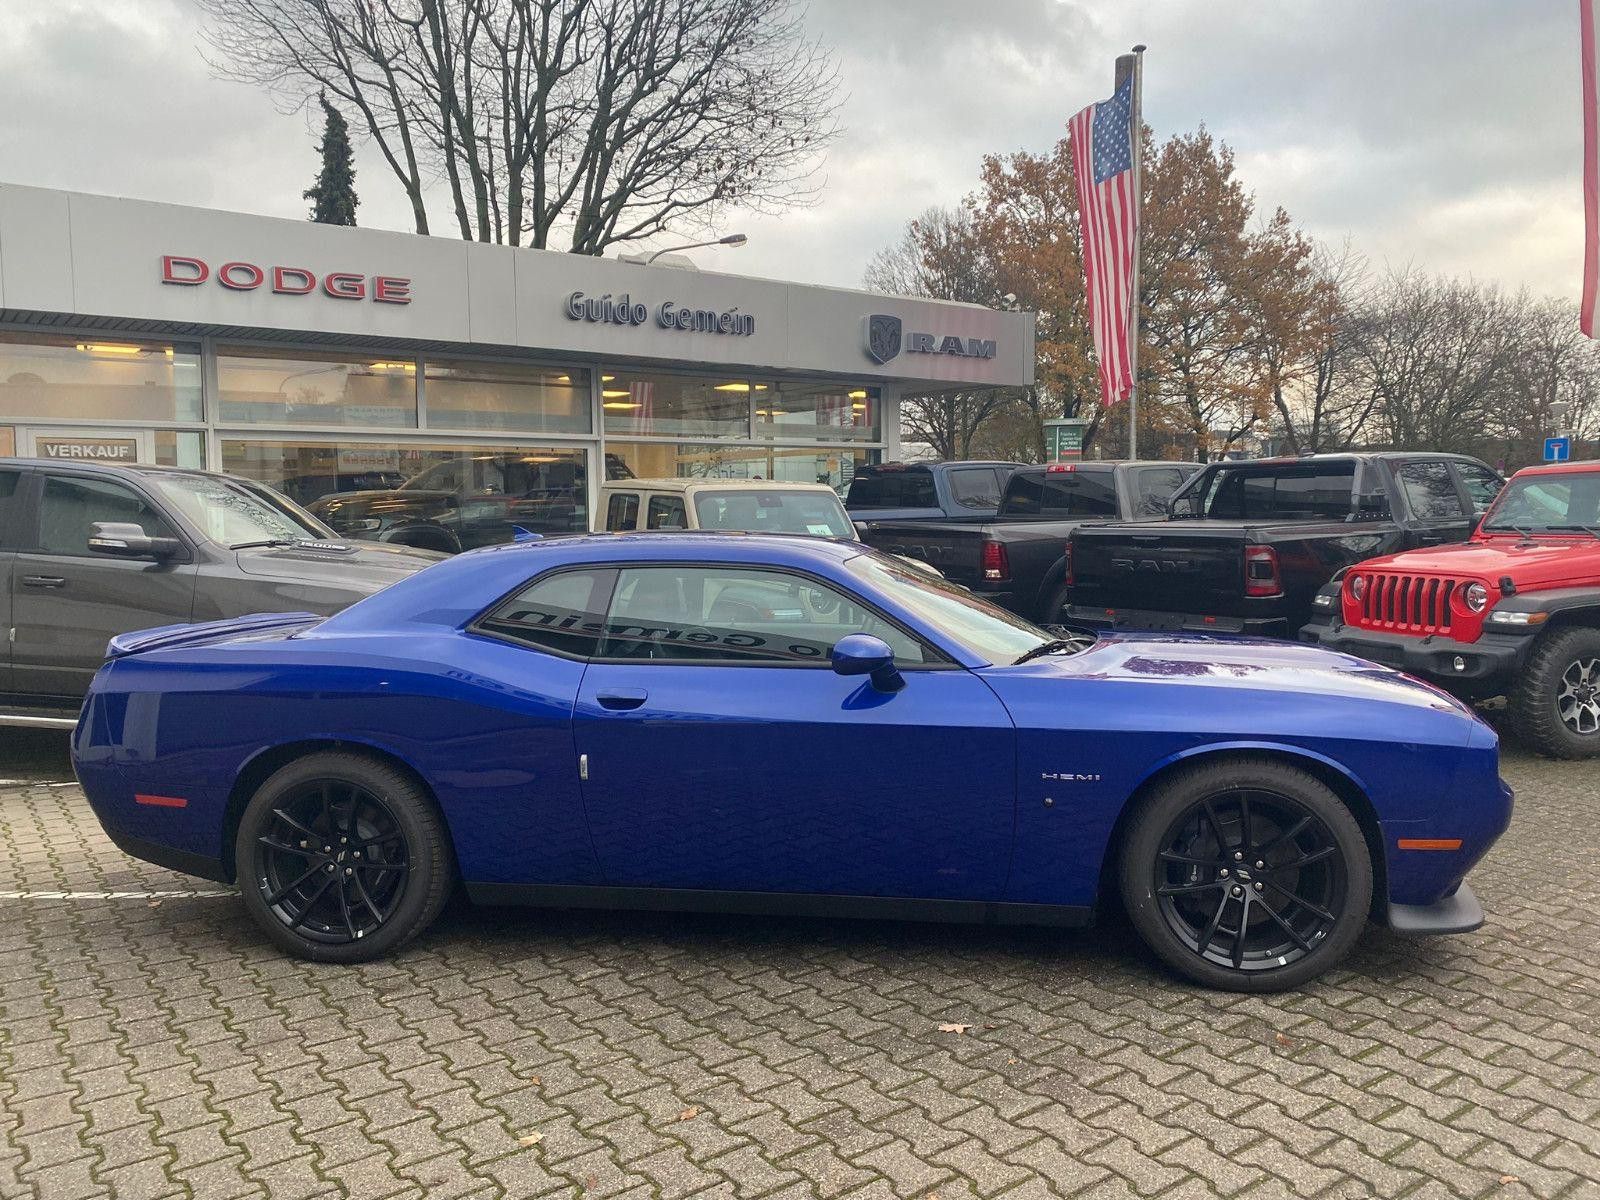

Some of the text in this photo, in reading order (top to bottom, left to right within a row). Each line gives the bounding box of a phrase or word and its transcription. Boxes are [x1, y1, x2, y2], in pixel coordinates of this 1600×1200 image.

[162, 255, 412, 304] DODGE
[566, 291, 756, 336] Guido Gemein
[907, 332, 997, 358] RAM
[46, 443, 129, 458] VERKAUF
